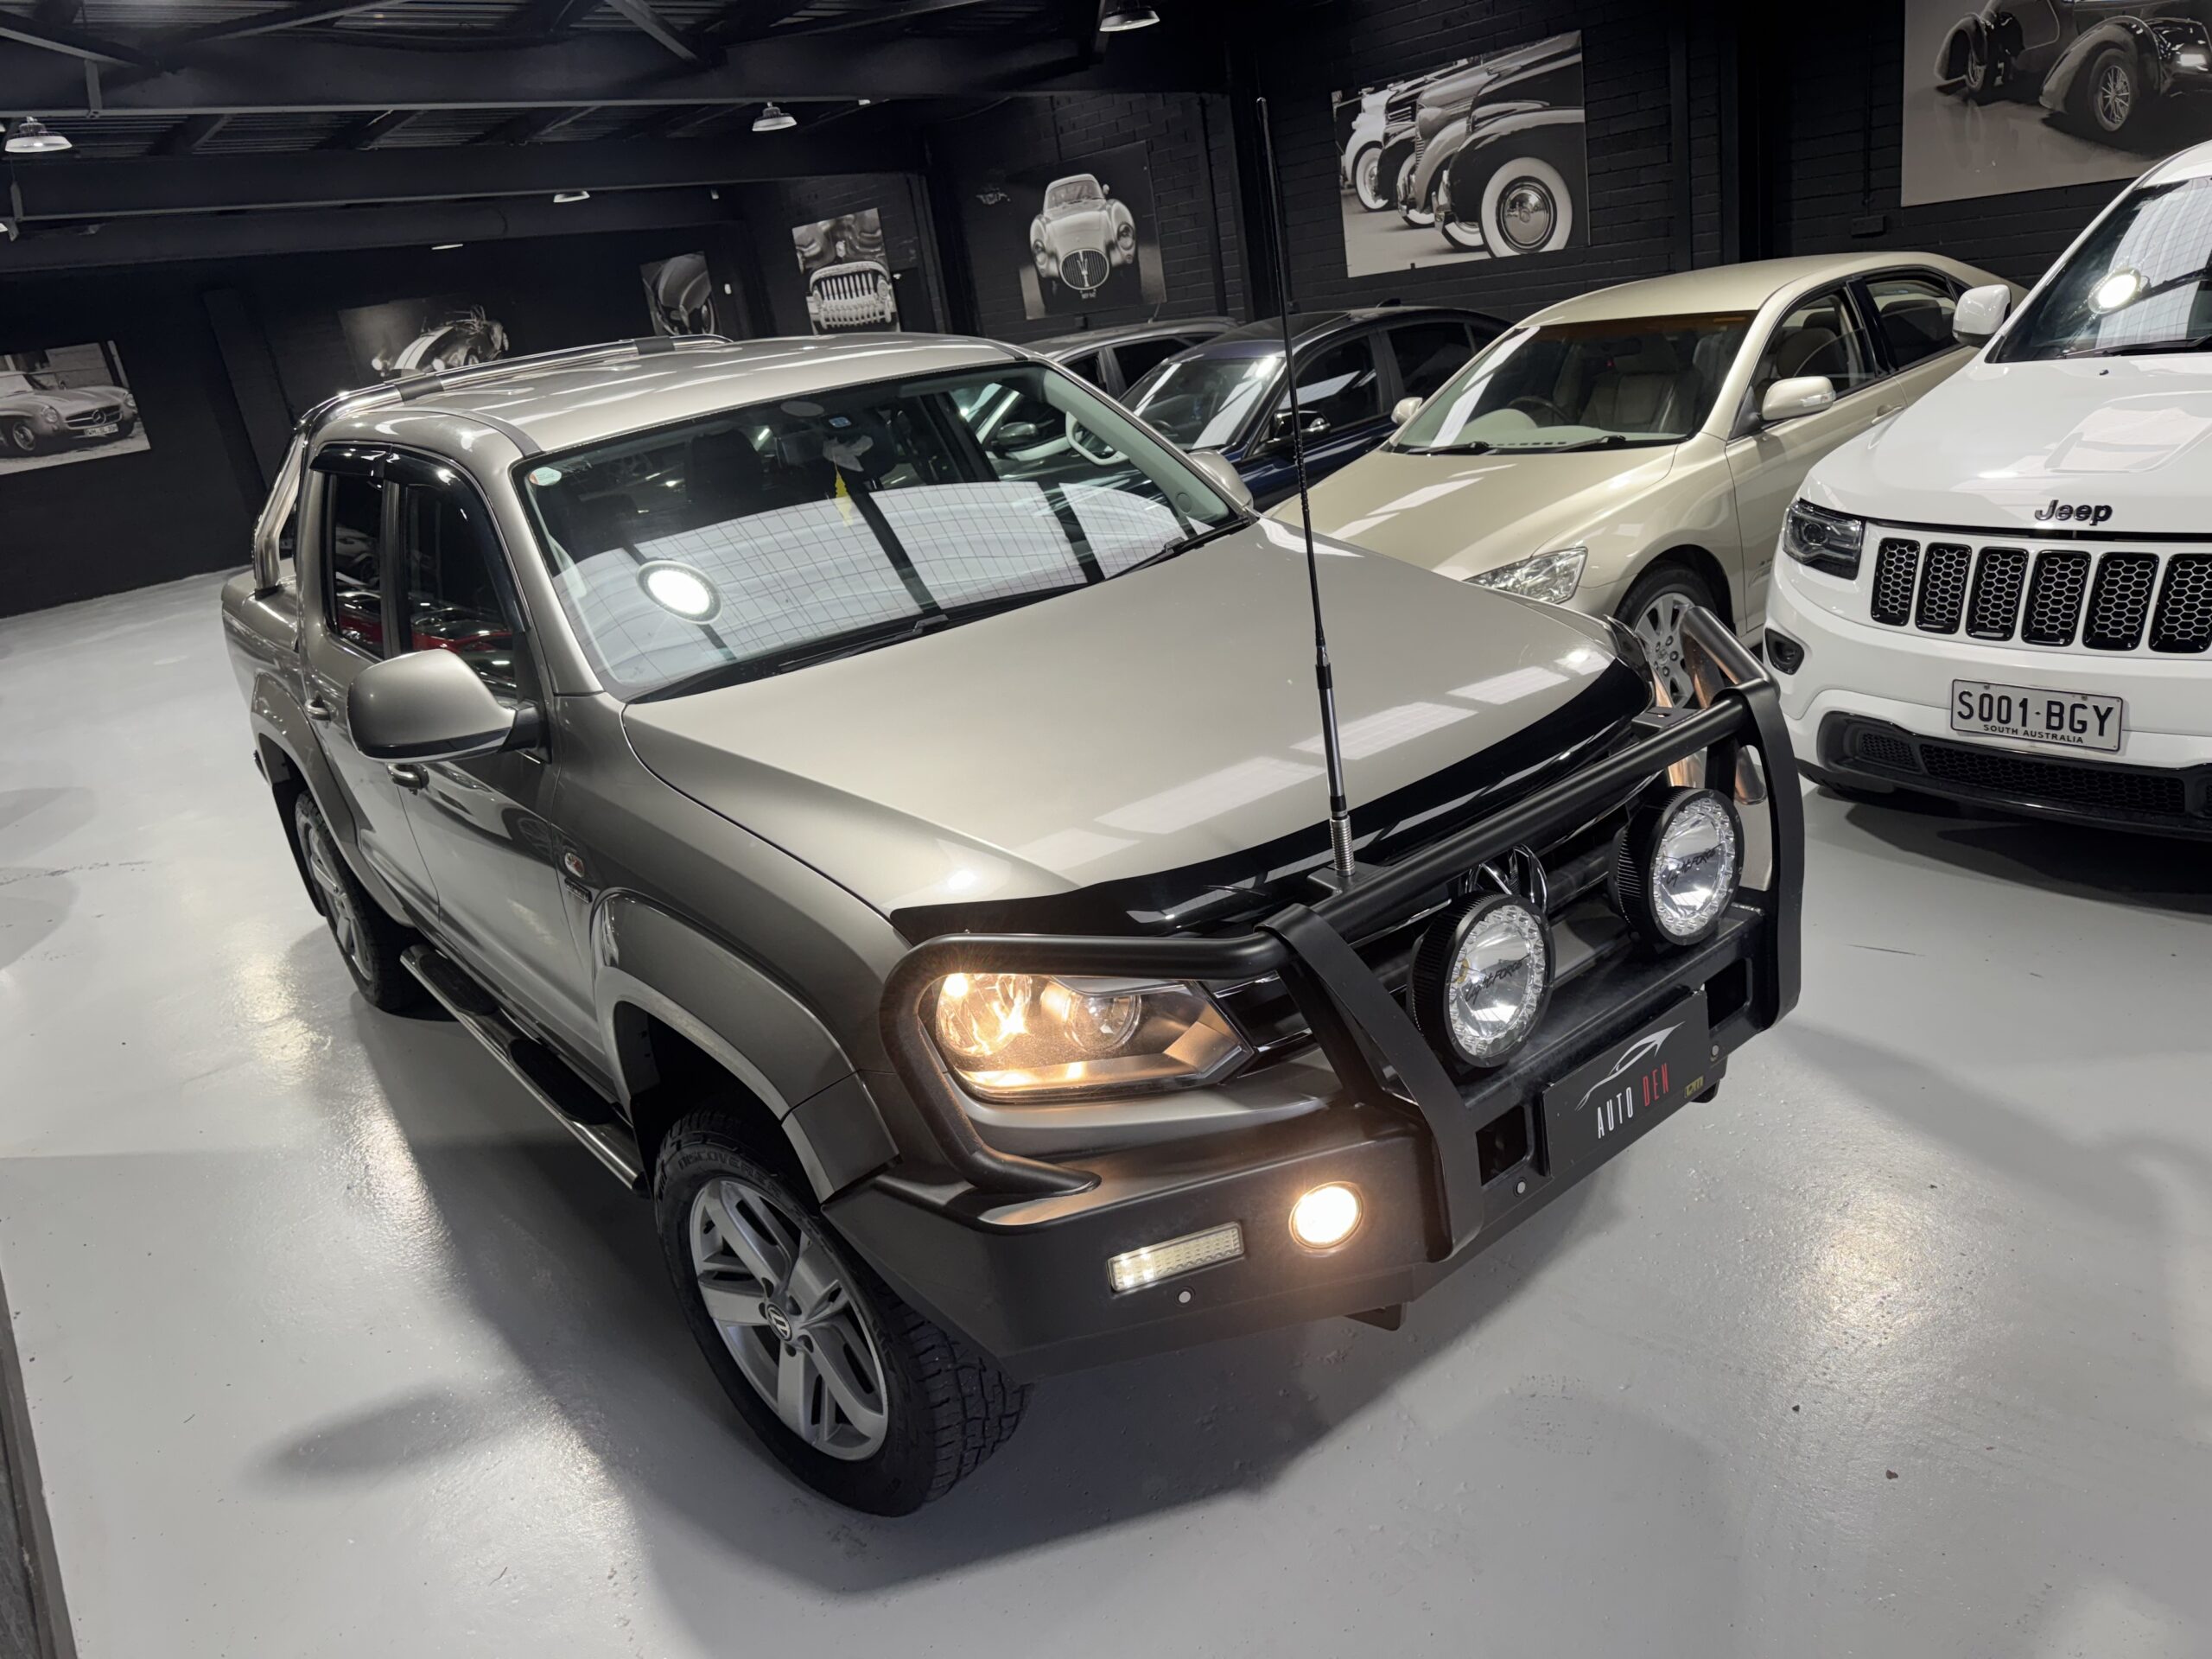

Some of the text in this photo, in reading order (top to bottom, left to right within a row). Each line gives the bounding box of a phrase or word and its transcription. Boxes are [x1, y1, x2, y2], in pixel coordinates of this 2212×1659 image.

[2034, 499, 2113, 526] Jeep
[1983, 723, 2084, 744] SOUTH AUSTRALIA
[1597, 1063, 1669, 1139] AUTO DEN
